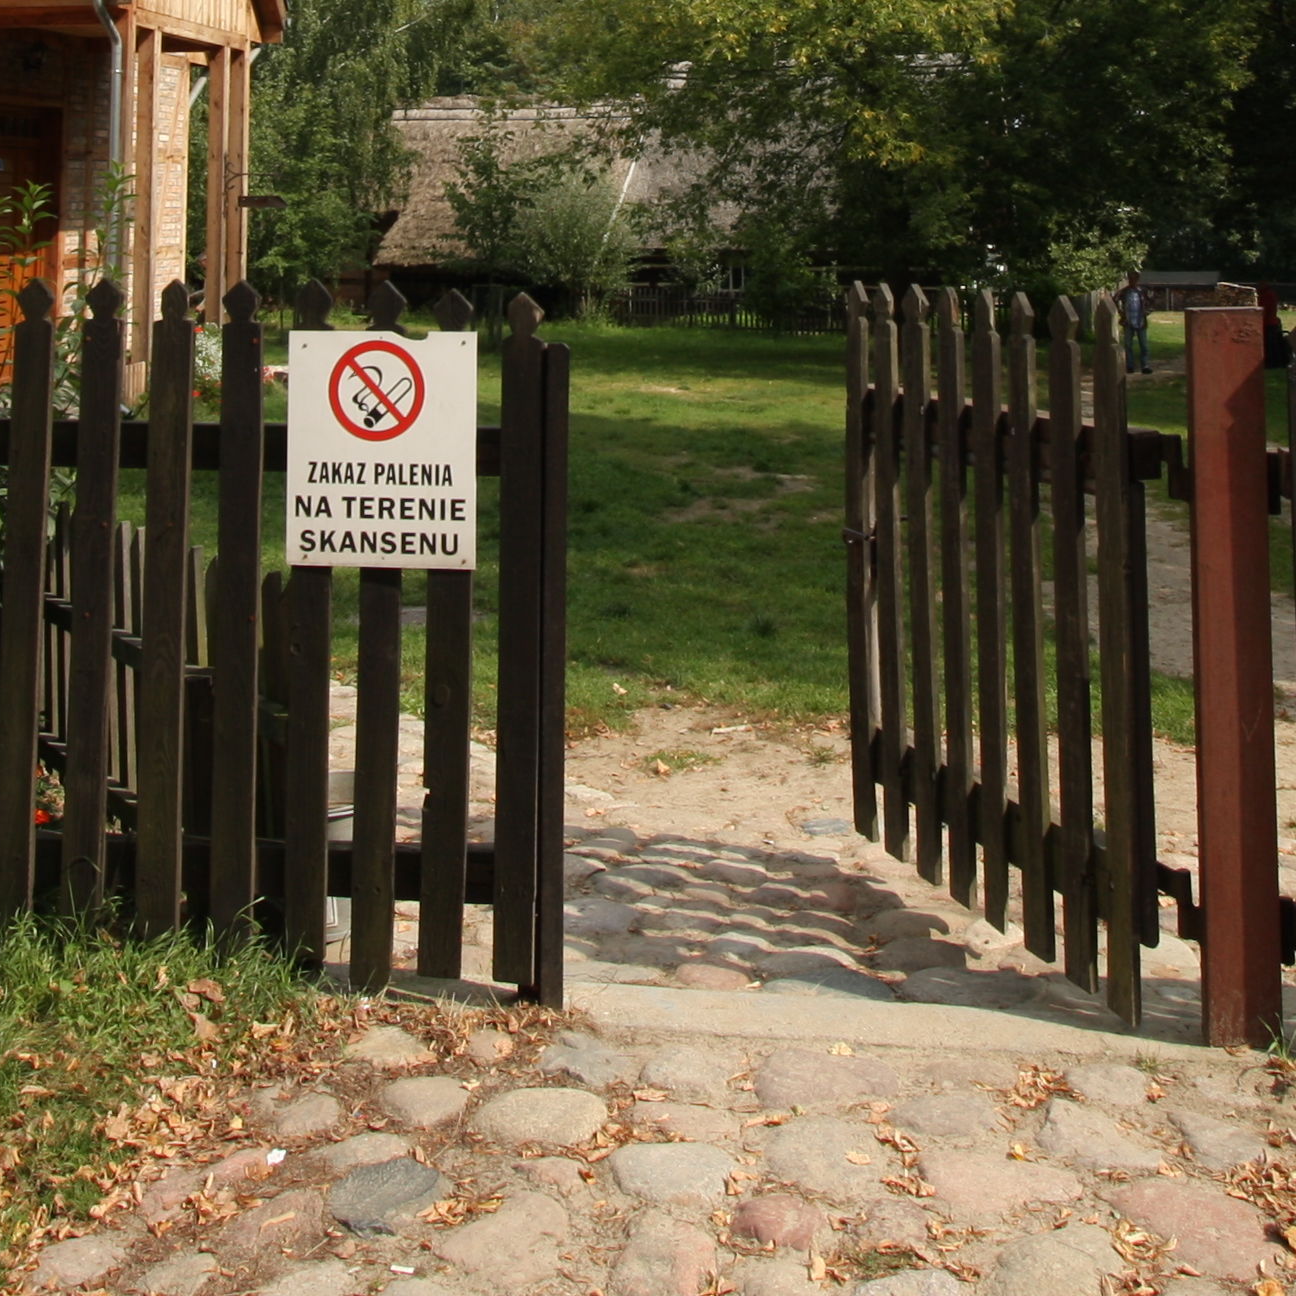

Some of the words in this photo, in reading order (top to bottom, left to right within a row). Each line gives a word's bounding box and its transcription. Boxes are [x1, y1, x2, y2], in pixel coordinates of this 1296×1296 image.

[307, 462, 366, 485] ZAKAZ
[374, 463, 453, 487] PALENIA
[295, 495, 332, 518] NA
[342, 496, 466, 521] TERENIE
[299, 530, 458, 556] SKANSENU
